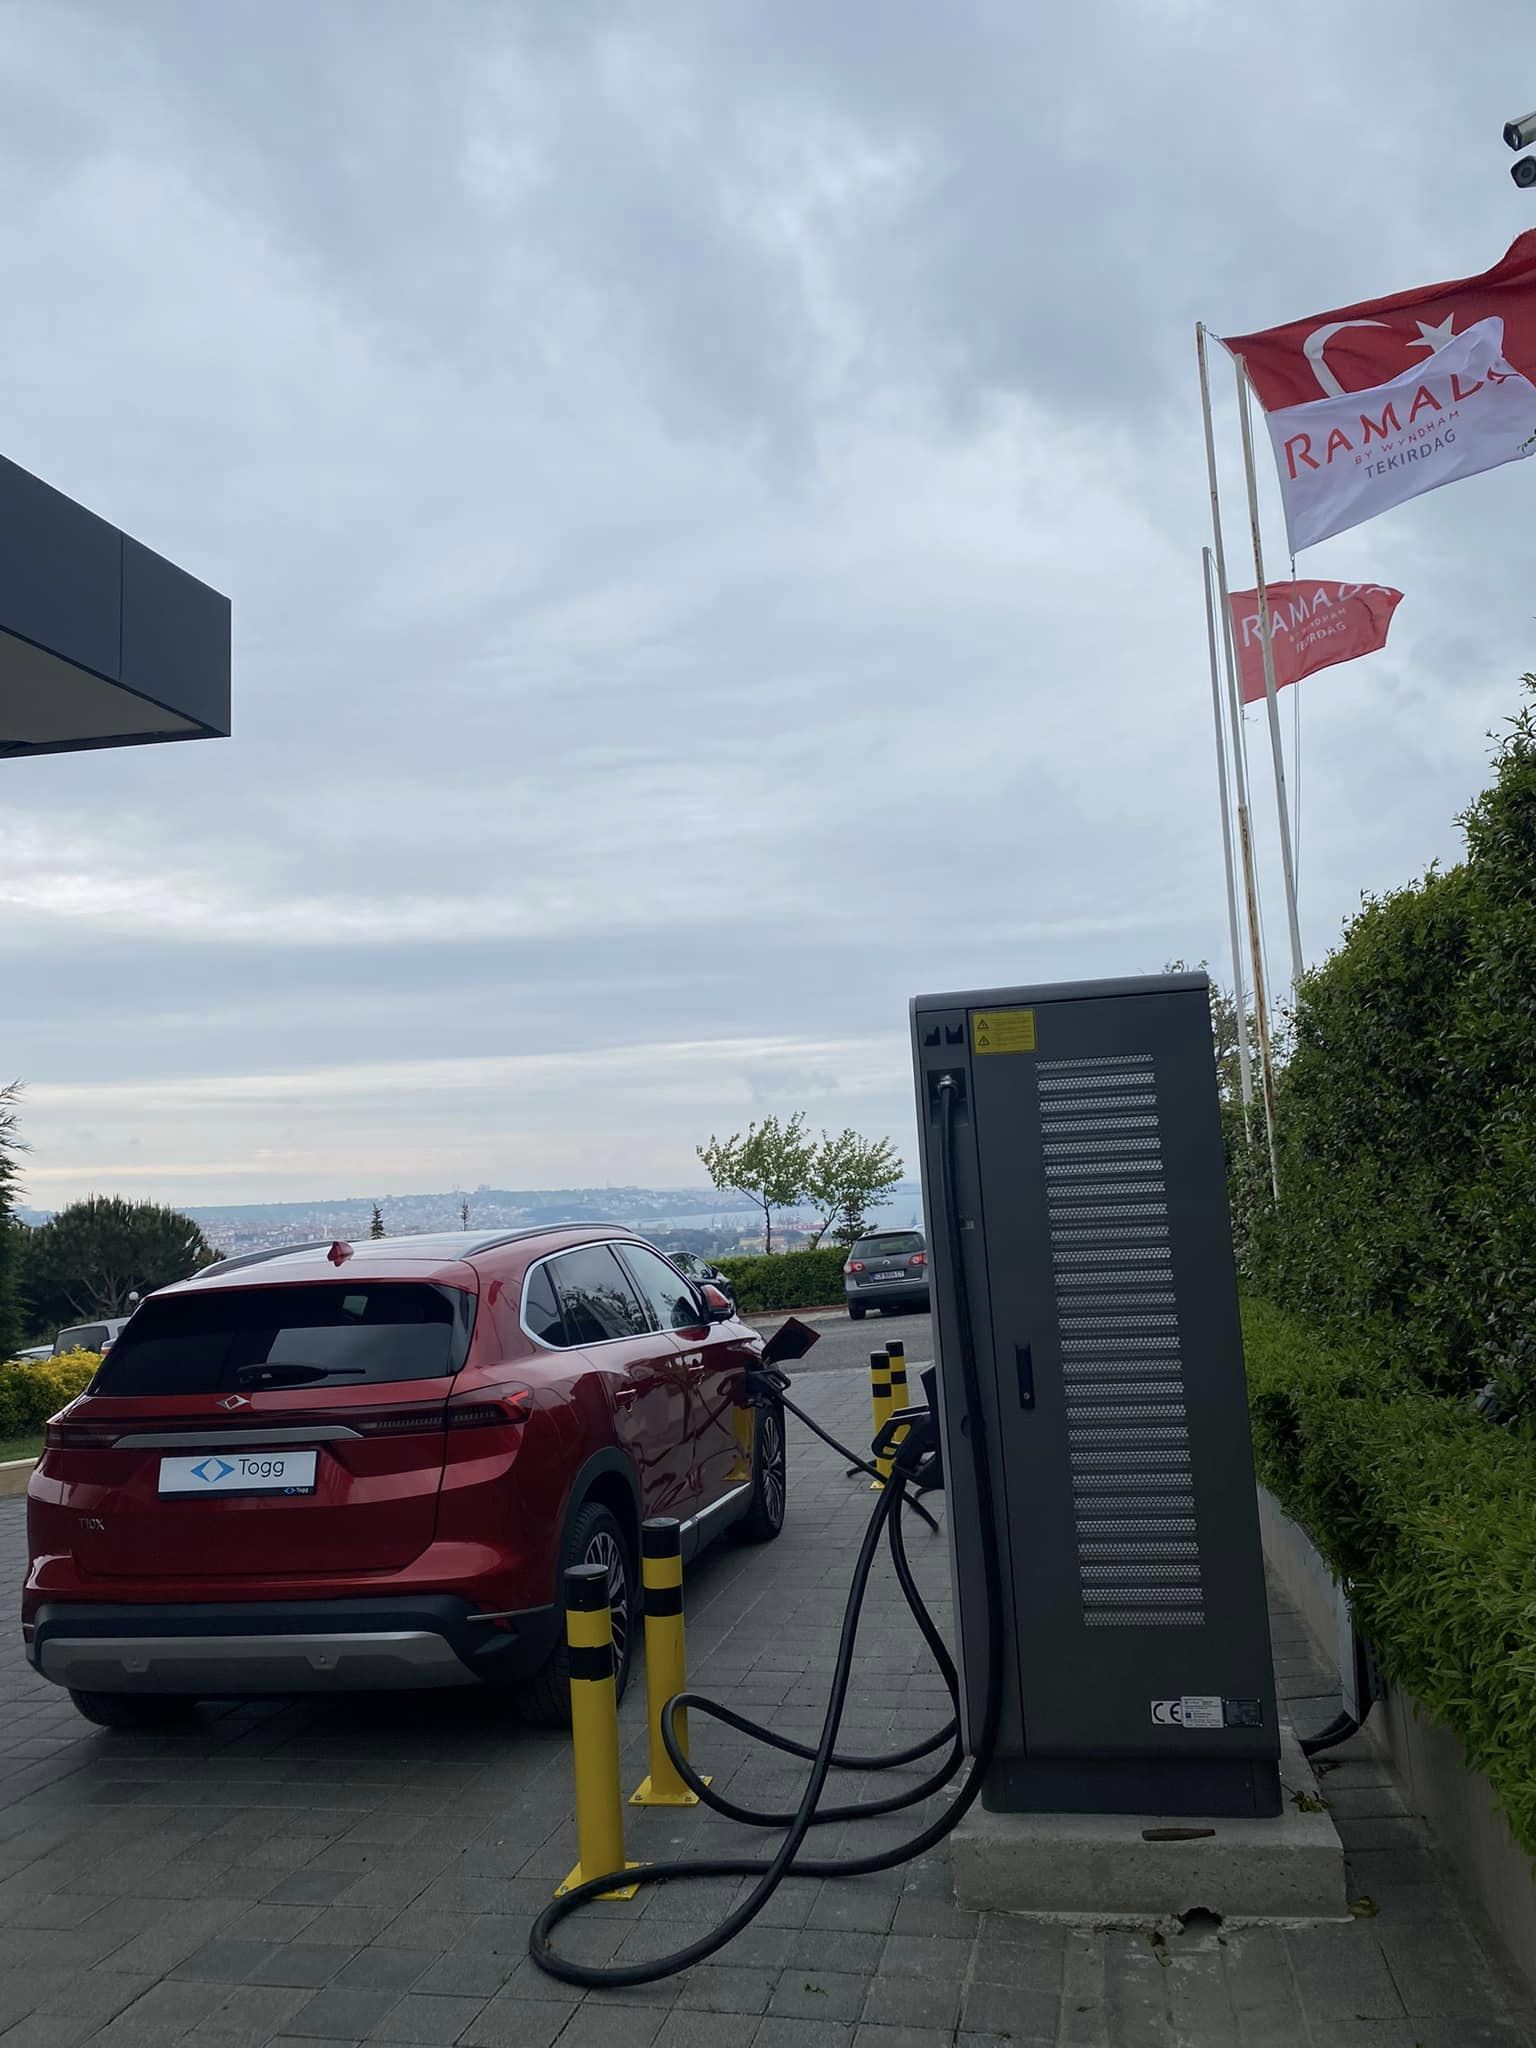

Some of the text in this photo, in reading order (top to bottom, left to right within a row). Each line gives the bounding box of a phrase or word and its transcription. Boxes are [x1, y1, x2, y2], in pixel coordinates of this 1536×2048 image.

[1355, 410, 1460, 465] BY WYNDHAM
[1364, 430, 1457, 479] TEKIRDAG
[239, 1458, 285, 1478] Togg
[1153, 1702, 1181, 1723] CE
